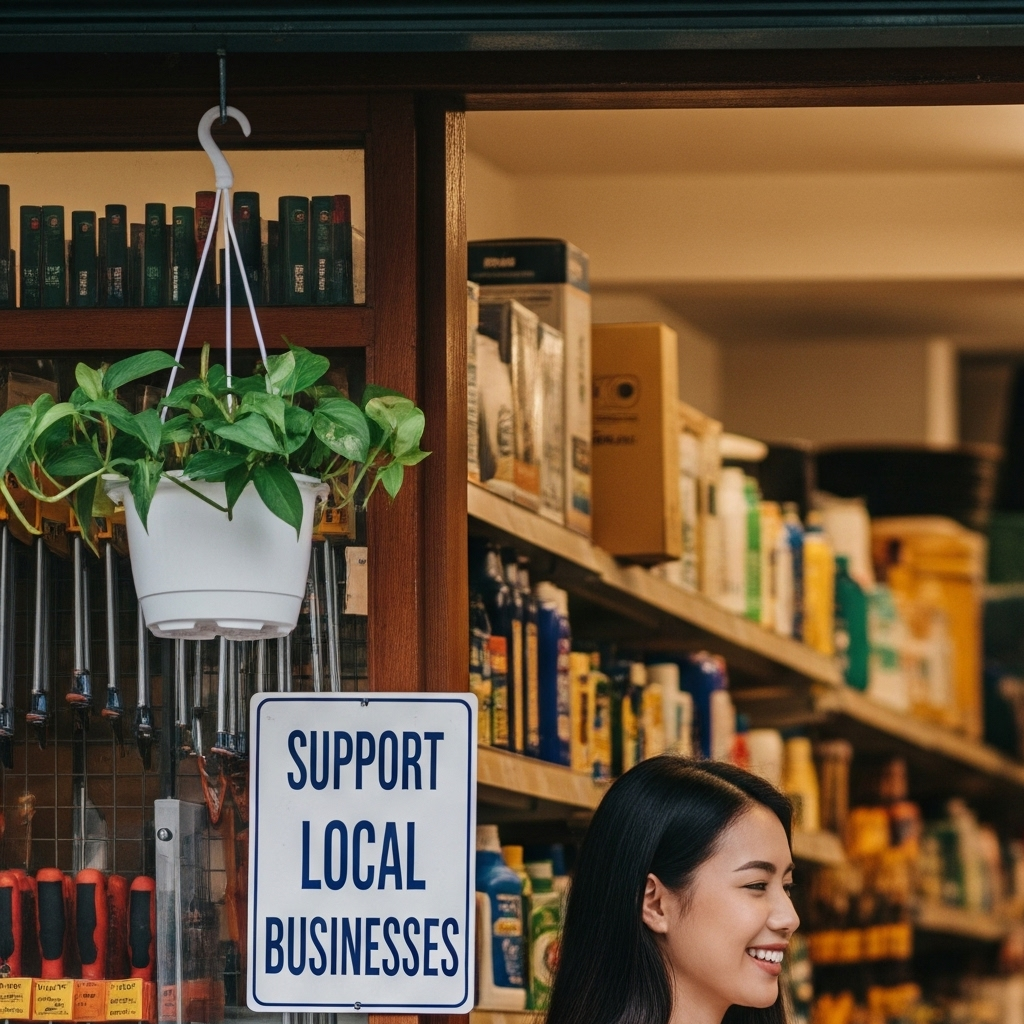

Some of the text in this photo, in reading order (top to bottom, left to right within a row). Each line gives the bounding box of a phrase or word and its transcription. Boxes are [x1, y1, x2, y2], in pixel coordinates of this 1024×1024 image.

[287, 729, 445, 791] SUPPORT
[301, 819, 426, 891] LOCAL
[265, 916, 460, 977] BUSINESSES
